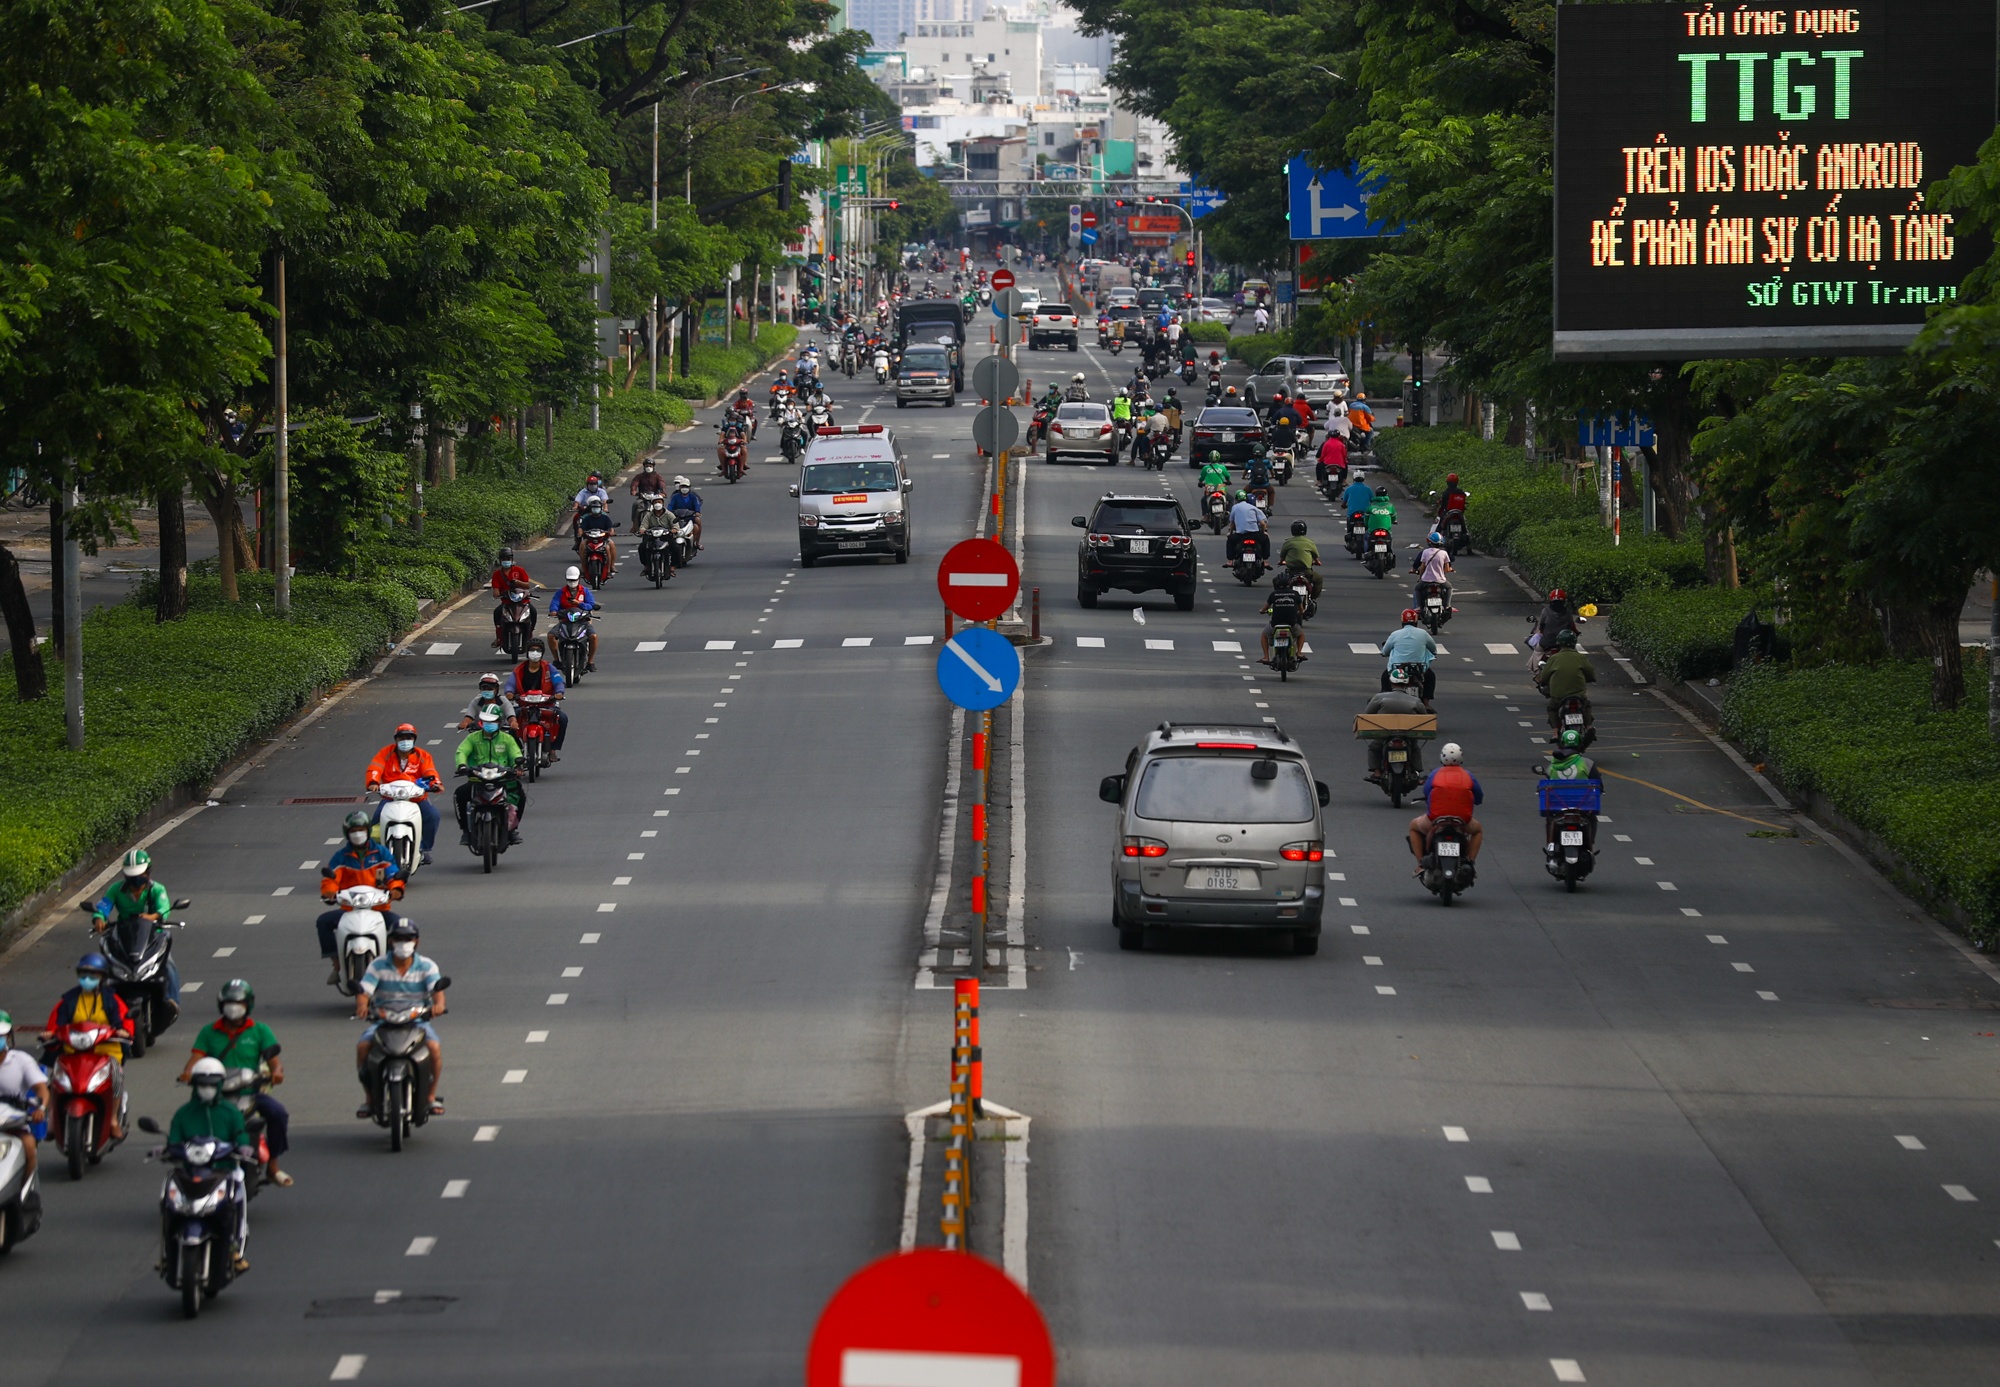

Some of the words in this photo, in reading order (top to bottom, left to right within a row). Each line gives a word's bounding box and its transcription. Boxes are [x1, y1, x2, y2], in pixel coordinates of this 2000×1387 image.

[1684, 3, 1725, 37] TẢI
[1733, 4, 1787, 36] ỨNG
[1795, 9, 1860, 38] DỤNG
[1678, 50, 1864, 122] TTGT
[1622, 133, 1686, 193] TRÊN
[1696, 145, 1736, 193] IOS
[1744, 131, 1809, 199] HOẶC
[1817, 142, 1924, 191] ANDROID
[1590, 197, 1626, 267] ĐỂ
[1632, 201, 1697, 266] PHẢN
[1704, 204, 1754, 265] ÁNH
[1761, 216, 1799, 272] SỰ
[1807, 193, 1843, 263] CỐ
[1848, 215, 1881, 271] HẠ
[1890, 192, 1955, 262] TẦNG
[1748, 276, 1783, 306] SỞ
[1793, 281, 1858, 305] GTVT
[1207, 878, 1238, 889] 018.52
[1214, 868, 1232, 878] 51D
